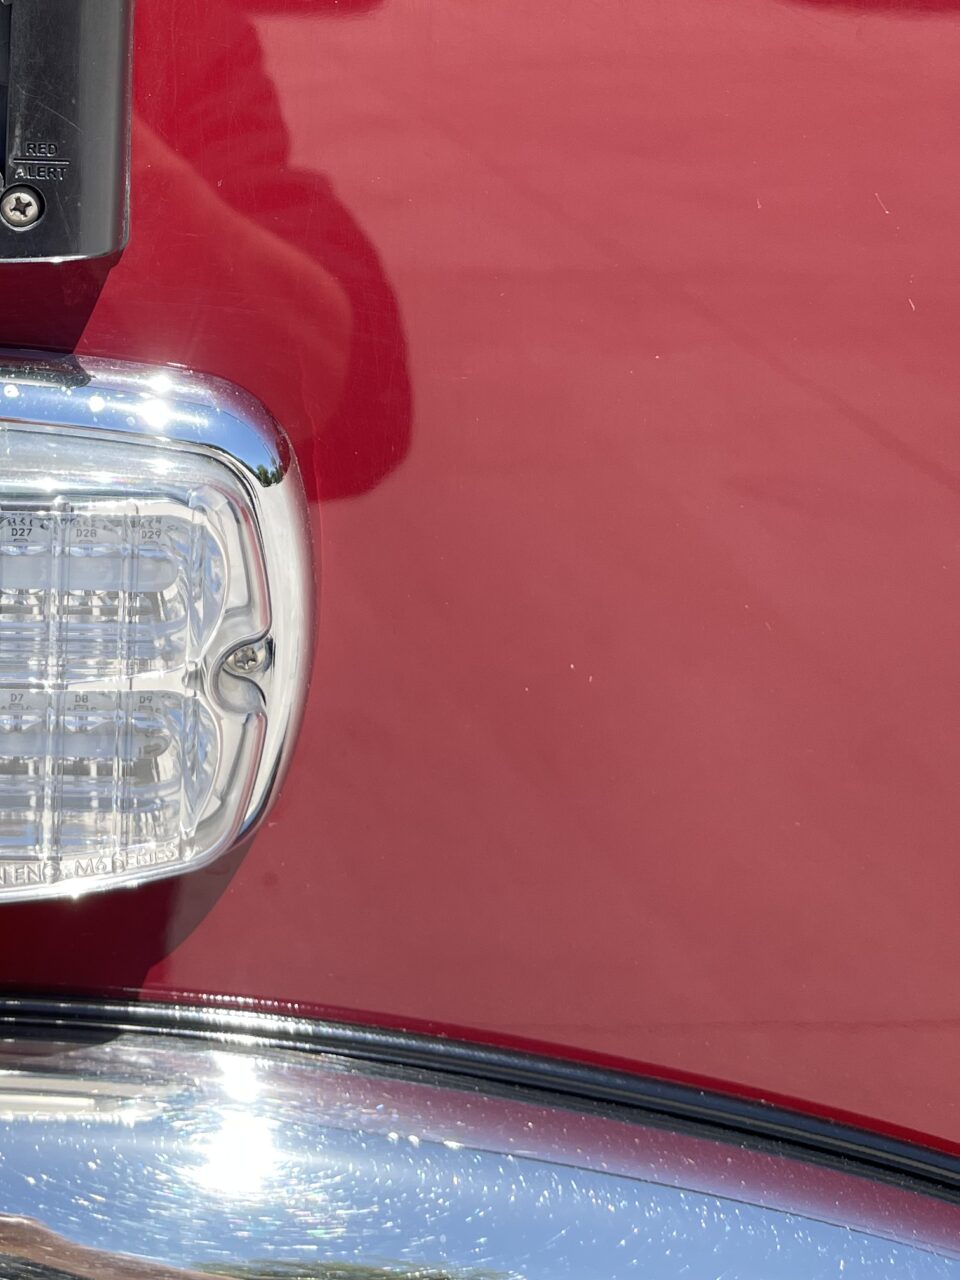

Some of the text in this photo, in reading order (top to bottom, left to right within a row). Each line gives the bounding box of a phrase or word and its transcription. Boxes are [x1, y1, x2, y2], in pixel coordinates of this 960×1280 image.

[25, 142, 58, 157] RED
[14, 165, 68, 181] ALERT
[11, 527, 33, 538] D27
[10, 693, 24, 703] D7
